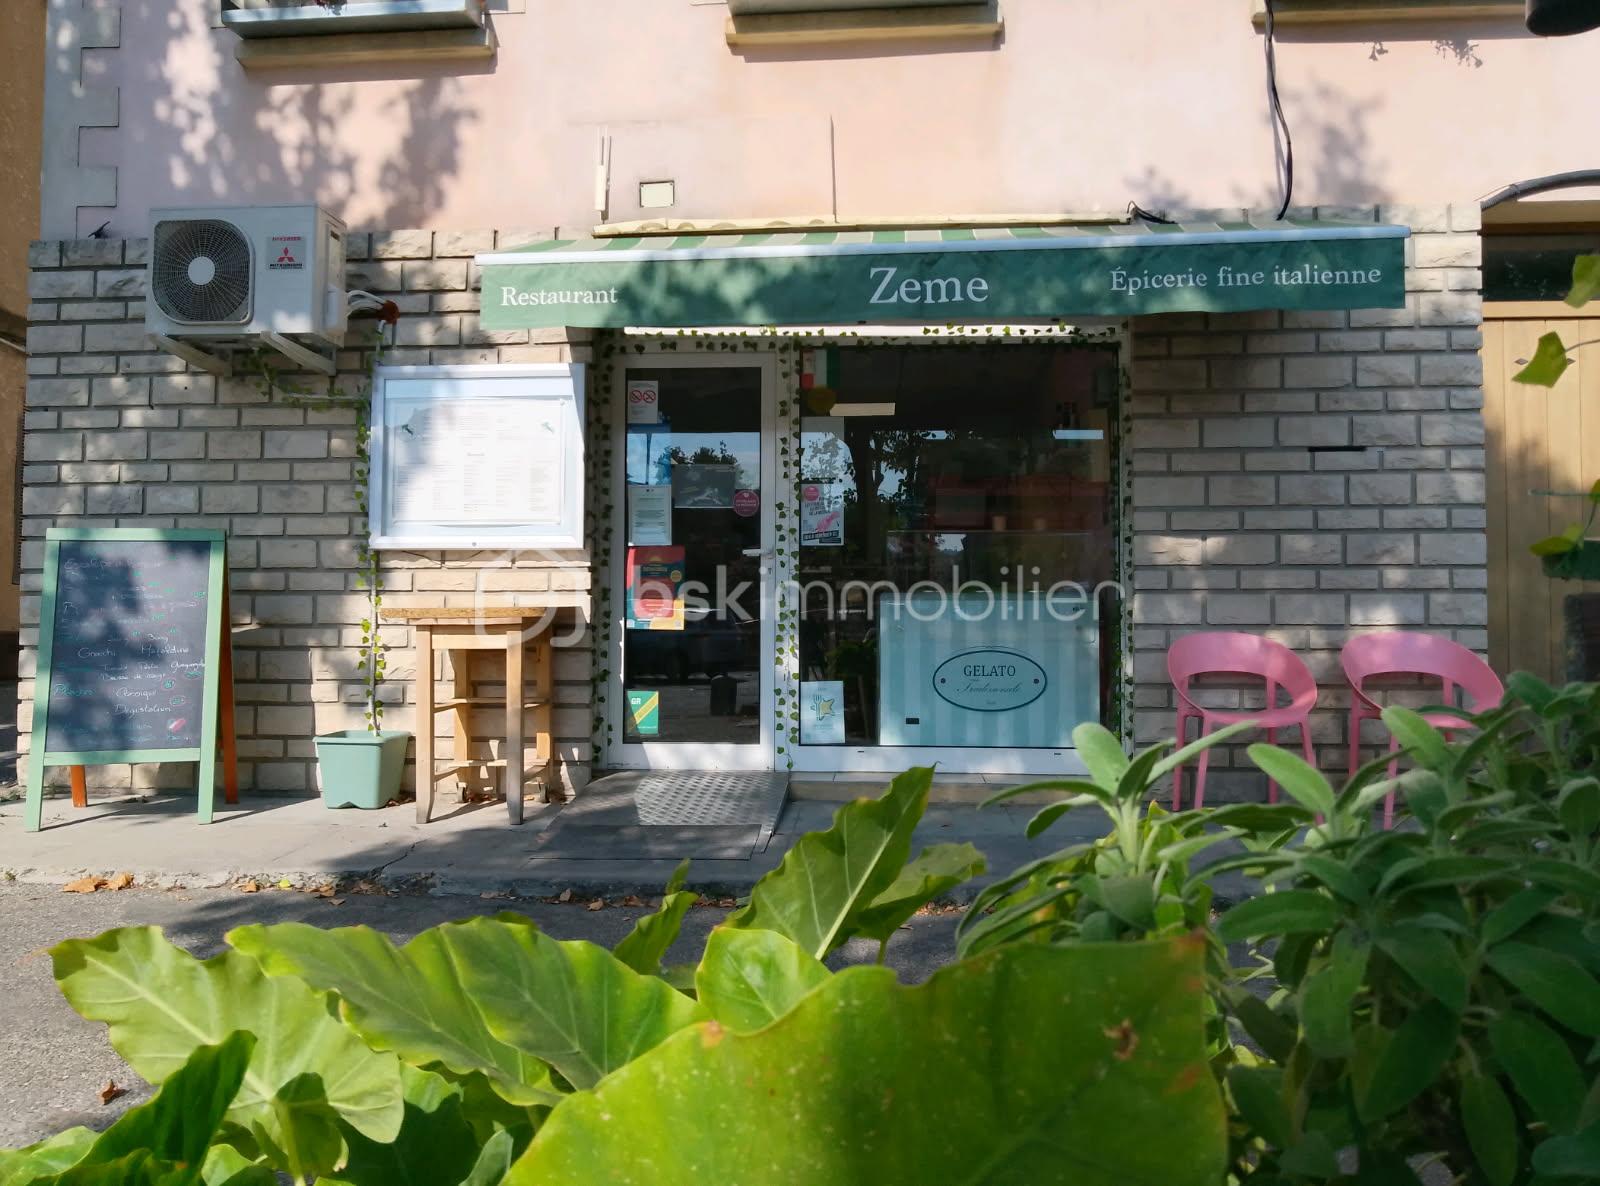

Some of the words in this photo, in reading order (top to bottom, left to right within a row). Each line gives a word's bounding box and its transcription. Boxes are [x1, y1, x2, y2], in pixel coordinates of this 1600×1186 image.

[869, 266, 989, 304] Zeme
[1109, 265, 1208, 296] Épicerie
[1216, 266, 1265, 287] fine
[1273, 263, 1382, 286] italienne
[500, 285, 618, 307] Restaurant
[963, 664, 1016, 677] GELATO
